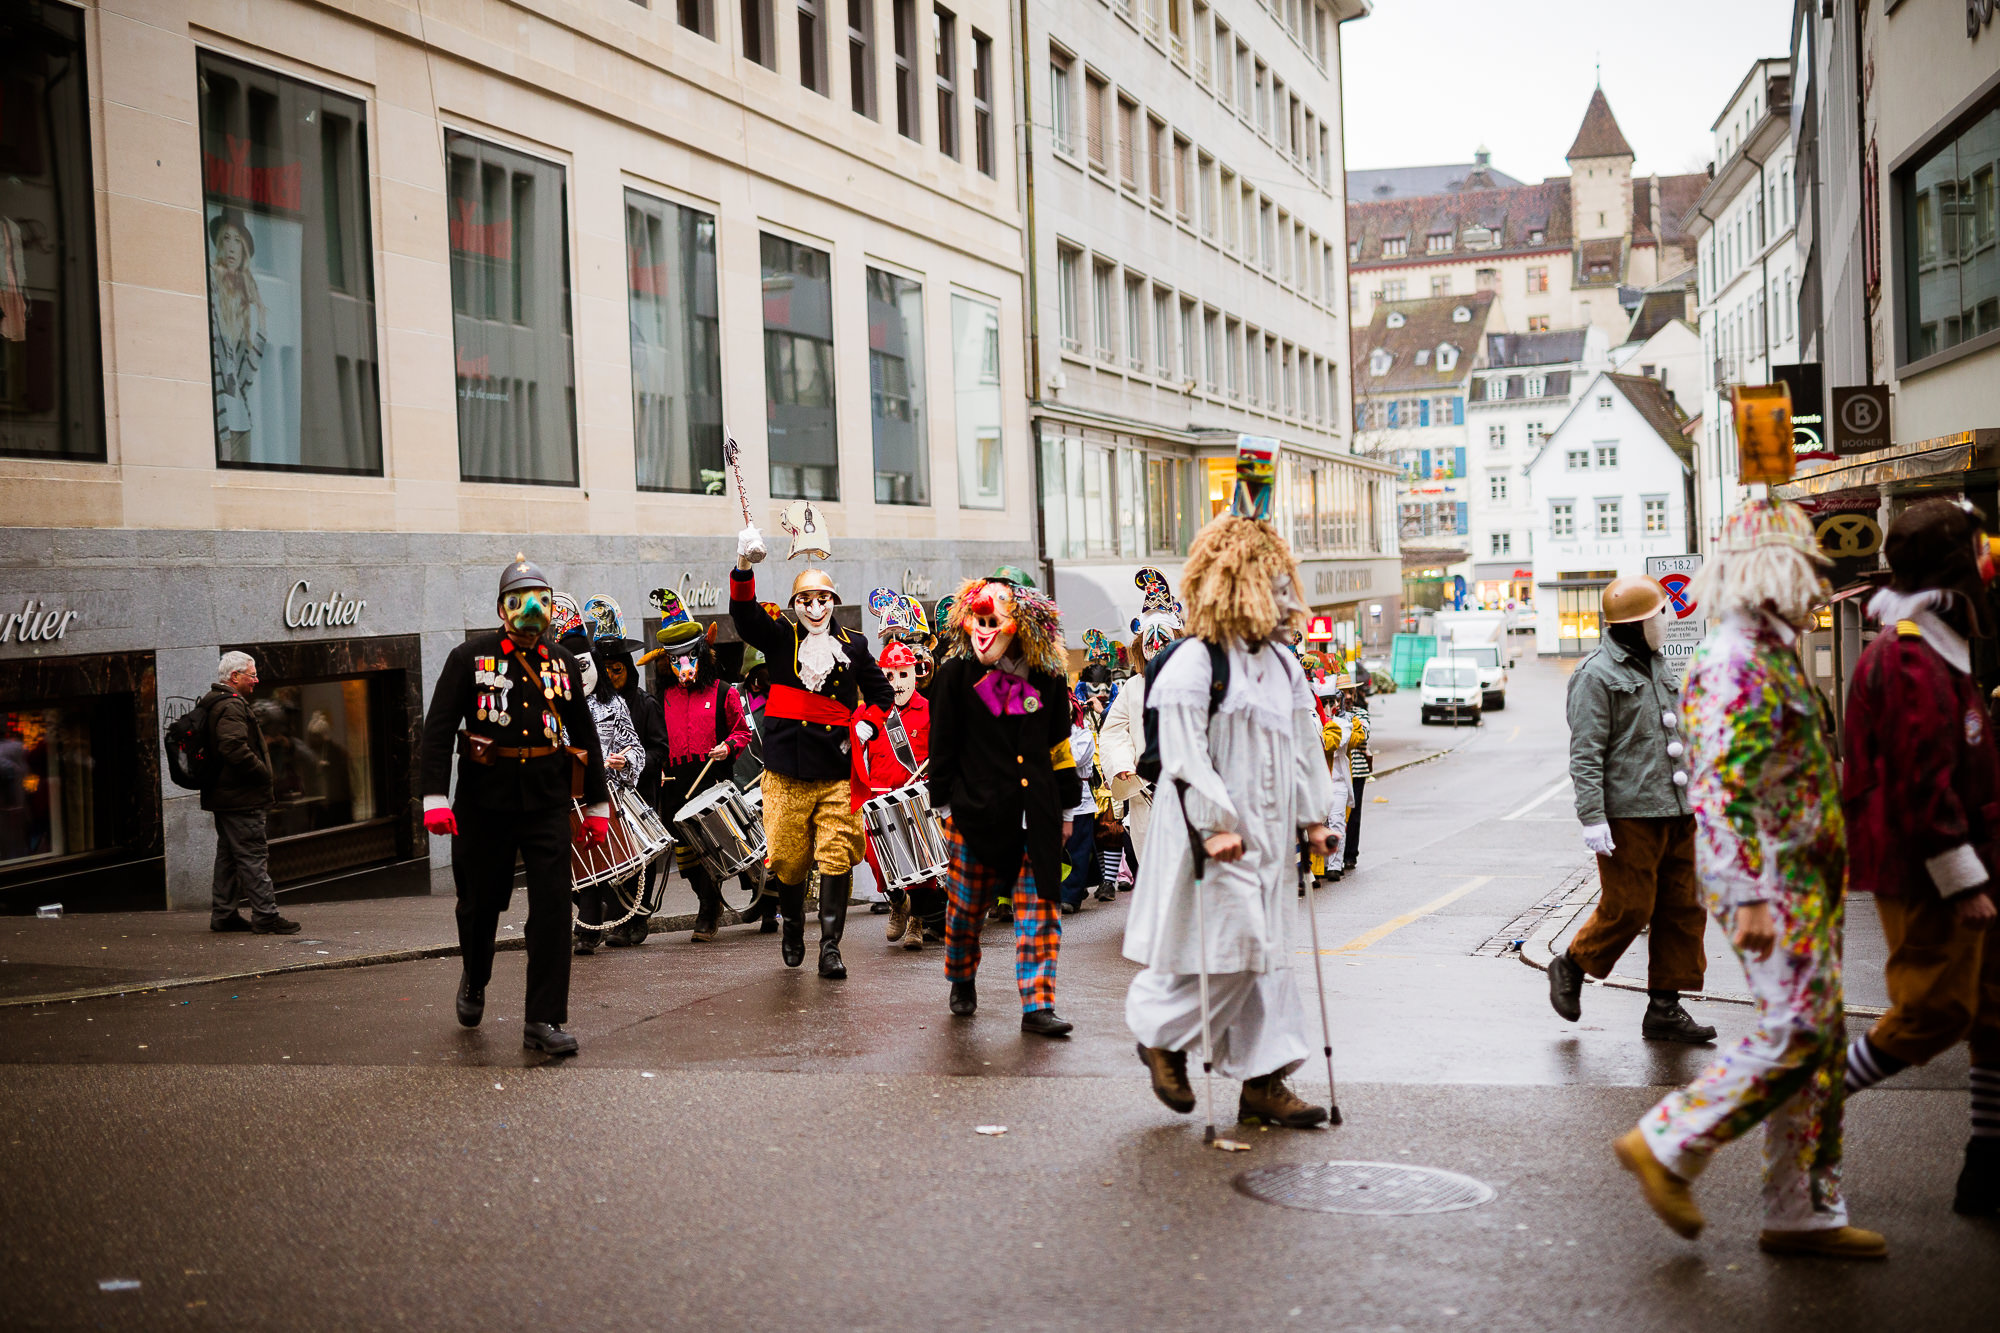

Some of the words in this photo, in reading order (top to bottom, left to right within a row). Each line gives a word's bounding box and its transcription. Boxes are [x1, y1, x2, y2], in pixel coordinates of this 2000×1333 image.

[1841, 438, 1884, 449] BOGNER
[678, 571, 723, 607] Cartier
[902, 567, 932, 596] Cartier
[284, 579, 367, 628] Cartier
